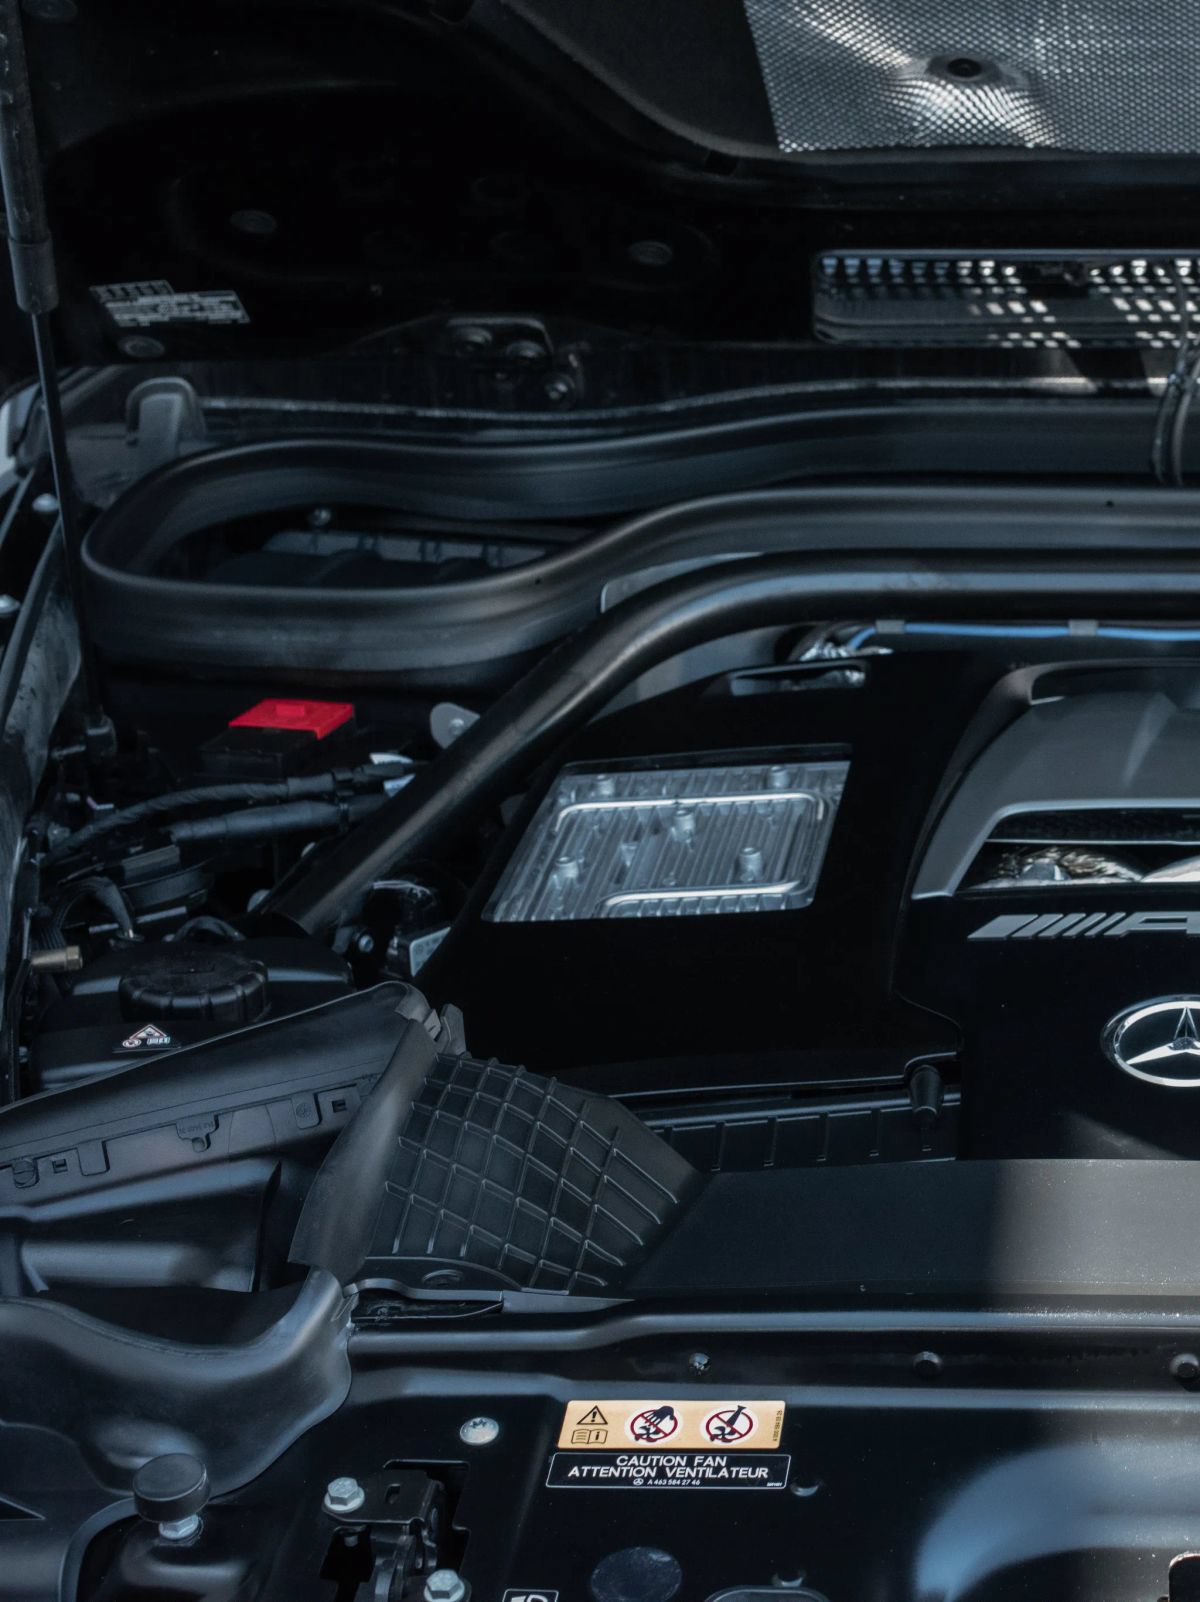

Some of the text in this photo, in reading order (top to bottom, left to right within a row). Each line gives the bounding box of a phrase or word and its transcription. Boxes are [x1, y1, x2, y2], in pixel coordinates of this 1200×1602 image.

[616, 1455, 728, 1467] CAUTION FAN
[567, 1466, 769, 1478] ATTENTION VENTILATEUR
